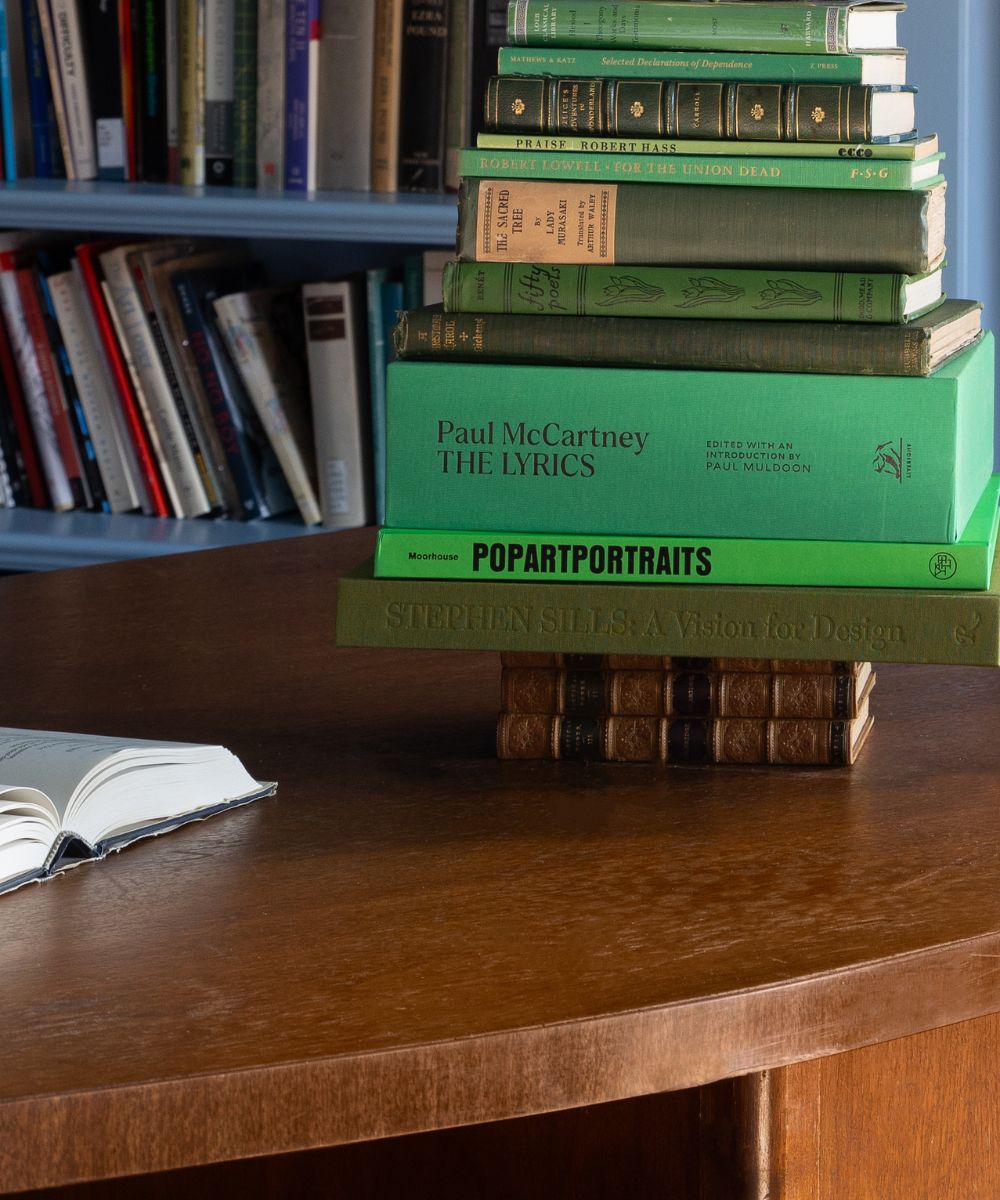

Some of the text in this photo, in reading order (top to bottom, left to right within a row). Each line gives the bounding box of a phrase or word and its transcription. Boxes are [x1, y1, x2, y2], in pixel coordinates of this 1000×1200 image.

[411, 10, 442, 21] EZRA
[406, 25, 447, 36] POUND
[601, 57, 635, 66] Selected
[636, 58, 689, 68] Declarations
[690, 59, 701, 69] of
[701, 59, 753, 71] Dependence
[579, 103, 585, 112] IN
[516, 139, 873, 158] PRAISE ROBERT HASS ecco
[480, 157, 537, 170] ROBERT
[542, 159, 601, 172] LOWELL
[614, 162, 641, 173] FOR
[648, 163, 676, 174] THE
[682, 162, 733, 176] UNION
[739, 165, 781, 177] DEAD
[498, 189, 510, 229] SACRED
[512, 208, 524, 235] TREE
[534, 216, 542, 227] By
[546, 210, 555, 235] LADY
[558, 199, 568, 246] MURASAKI
[576, 199, 586, 247] Translated by
[518, 265, 549, 312] fifty
[548, 266, 568, 311] poets
[437, 420, 649, 456] Paul McCartney
[706, 440, 793, 450] EDITED WITH AN
[437, 450, 595, 478] THE LYRICS
[706, 451, 801, 461] INTRODUCTION BY
[706, 461, 811, 473] PAUL MULDOON
[408, 543, 712, 577] Moorhouse POPARTPORTRAITS
[385, 601, 905, 650] STEPHEN SILLS: A Vision for Design
